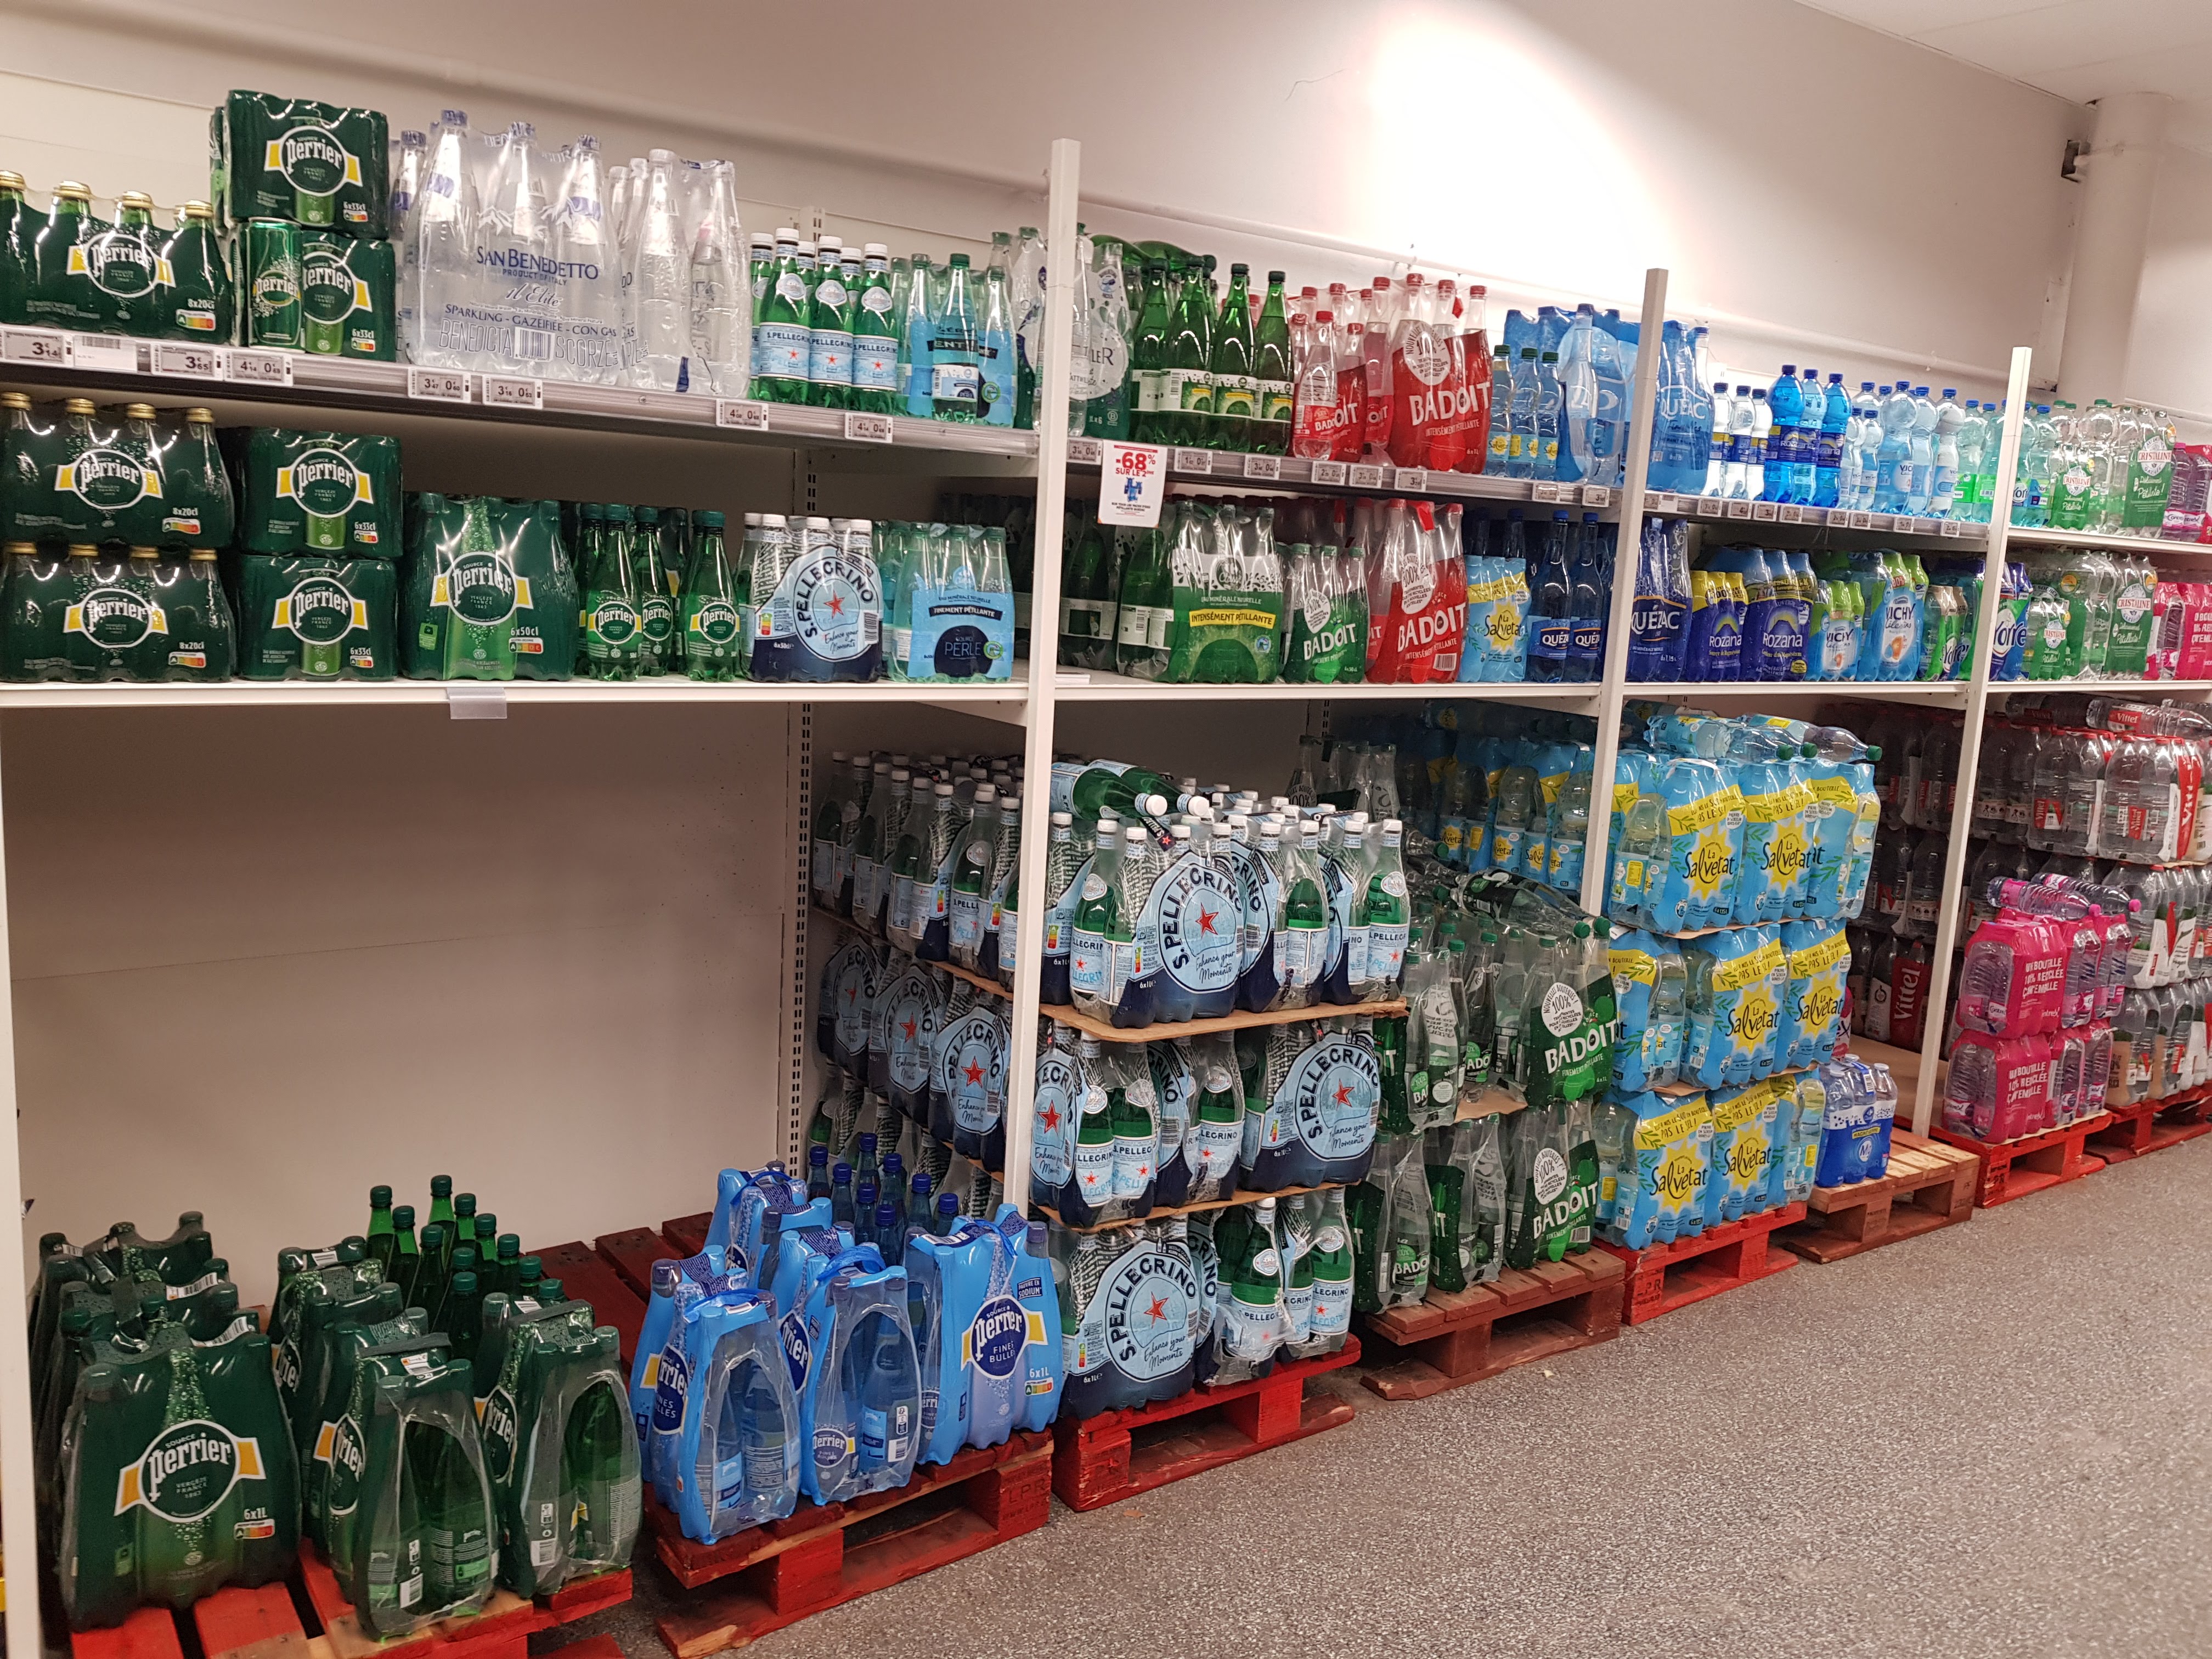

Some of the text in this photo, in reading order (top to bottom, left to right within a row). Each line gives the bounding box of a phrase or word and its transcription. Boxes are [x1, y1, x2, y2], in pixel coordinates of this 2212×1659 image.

[477, 246, 599, 280] SAN BENEDETTO
[503, 268, 537, 280] PRODUCT
[548, 275, 567, 286] ITALY
[445, 304, 503, 323] SPARKLING
[573, 325, 598, 336] CON
[601, 327, 617, 337] GAS
[439, 319, 513, 358] BENEDICTA
[1408, 381, 1491, 426] BADOIT
[1116, 467, 1130, 476] SUR
[172, 507, 199, 516] 8x20cl
[354, 521, 376, 531] 6x33cl
[797, 561, 874, 638] S.PELLEGRINO
[1192, 611, 1273, 625] INTENSÉMENT PÉTILLANTE
[1886, 603, 1916, 620] VICHY
[510, 626, 539, 636] 6x50cl
[1397, 602, 1466, 652] BADOIT
[1826, 628, 1854, 642] VICHY
[179, 641, 205, 651] 8x20cl
[944, 642, 982, 657] PERLE
[1304, 623, 1356, 661] BADOIT
[350, 647, 371, 657] 6x33cl
[1786, 840, 1793, 850] La
[1708, 849, 1716, 859] La
[1760, 838, 1812, 875] Salvetat
[1682, 847, 1735, 884] Salvetat
[1221, 951, 1235, 967] your
[1808, 956, 1830, 969] PAS LE
[1199, 962, 1233, 984] Moments
[1739, 967, 1761, 980] PAS LE
[1820, 994, 1827, 1003] La
[1893, 967, 1921, 1021] Vittel
[1551, 995, 1571, 1014] 100%
[1753, 1007, 1759, 1015] La
[1795, 992, 1843, 1026] Salvetat
[1725, 1005, 1780, 1040] Salvetat
[1544, 1019, 1617, 1074] BADOIT
[1733, 1107, 1754, 1121] PAS LE
[1661, 1129, 1673, 1139] PAS
[1677, 1125, 1684, 1134] LE
[1723, 1143, 1771, 1178] Salvetat
[1677, 1165, 1685, 1175] La
[1650, 1161, 1708, 1199] Salvetat
[1533, 1181, 1598, 1239] BADOIT
[1018, 1282, 1034, 1290] PAUVRE
[986, 1306, 1007, 1318] SOURCE
[1109, 1257, 1197, 1362] S.PELLEGRINO
[1144, 1335, 1186, 1362] Enhance your
[1149, 1347, 1183, 1372] Moments
[1029, 1367, 1049, 1378] 6x1L
[165, 1433, 196, 1448] SOURCE
[243, 1506, 268, 1520] 6x1L
